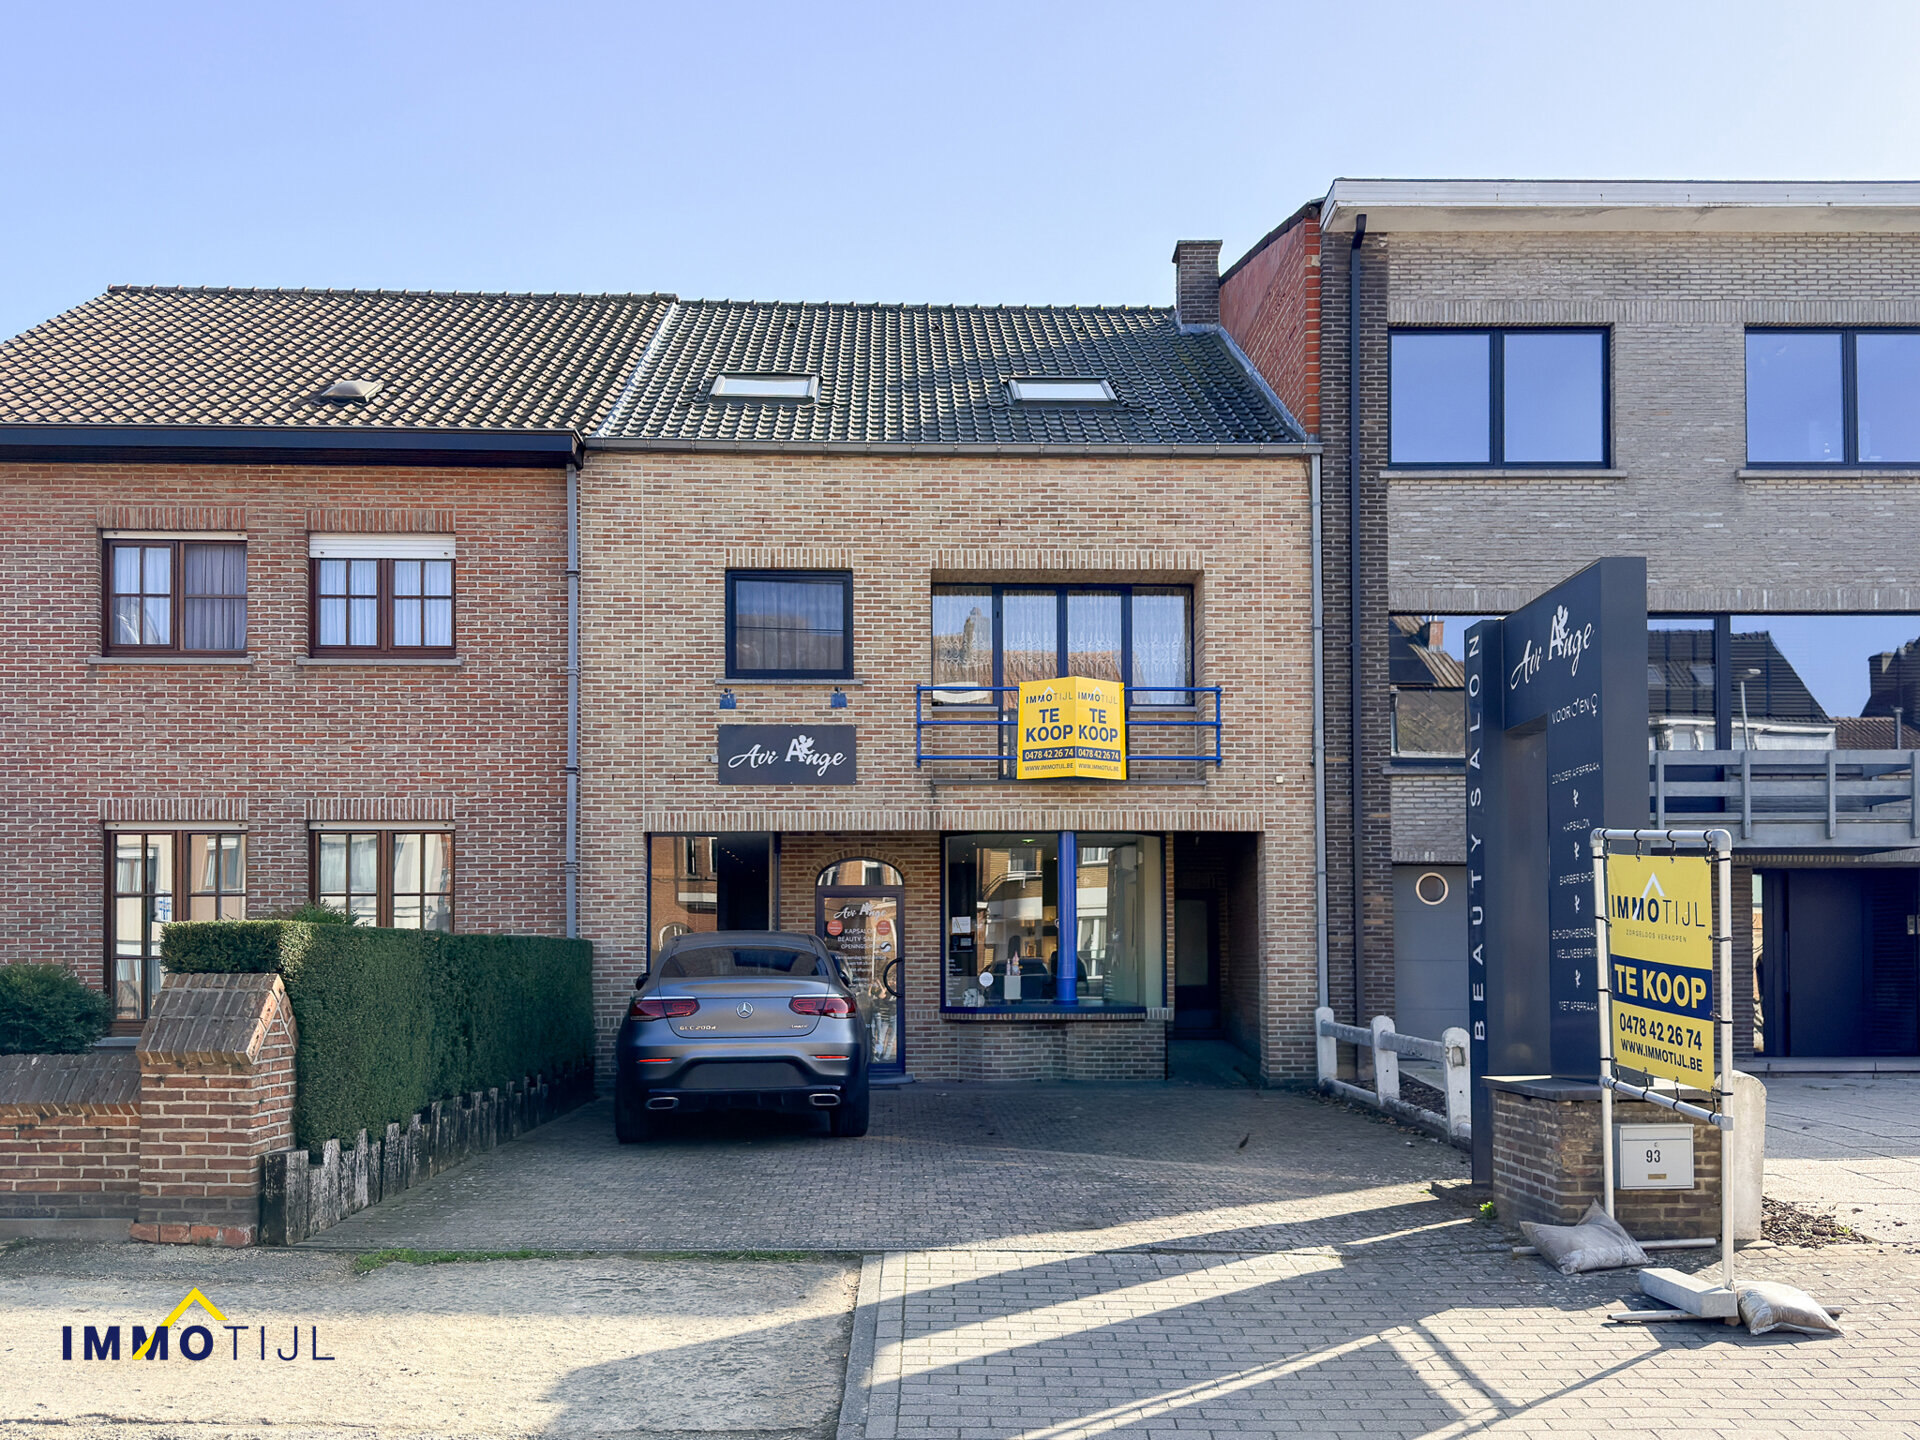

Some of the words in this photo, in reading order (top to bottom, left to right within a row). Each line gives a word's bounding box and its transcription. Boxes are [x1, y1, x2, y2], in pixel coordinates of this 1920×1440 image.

[1510, 639, 1544, 691] Avi
[1548, 605, 1594, 677] Ange
[1026, 691, 1073, 704] IMMOTIJL
[1078, 691, 1118, 704] IMMOTIJL
[1039, 708, 1060, 724] TE
[1089, 708, 1106, 724] TE
[1552, 706, 1571, 724] VOOR
[1580, 698, 1590, 714] EN
[1468, 634, 1481, 808] SALON
[1026, 724, 1073, 742] KOOP
[1078, 724, 1118, 742] KOOP
[728, 744, 778, 768] Avi
[785, 735, 846, 776] Ange
[1025, 750, 1042, 760] 0478
[1044, 750, 1053, 758] 42
[1054, 749, 1063, 758] 26
[1064, 748, 1074, 757] 74
[1078, 749, 1093, 758] 0478
[1094, 750, 1102, 758] 42
[1103, 751, 1110, 759] 26
[1112, 752, 1119, 760] 74
[1560, 874, 1580, 886] BARBER
[1611, 894, 1706, 927] IMMOTIJL
[1470, 834, 1486, 1041] BEAUTY
[1614, 962, 1638, 997] TE
[1642, 967, 1707, 1009] KOOP
[1620, 1012, 1647, 1037] 0478
[1649, 1020, 1664, 1042] 42
[1668, 1024, 1682, 1048] 26
[1686, 1028, 1702, 1051] 74
[1620, 1038, 1703, 1072] WWW.IMMOTIJL.BE
[1646, 1150, 1660, 1163] 93
